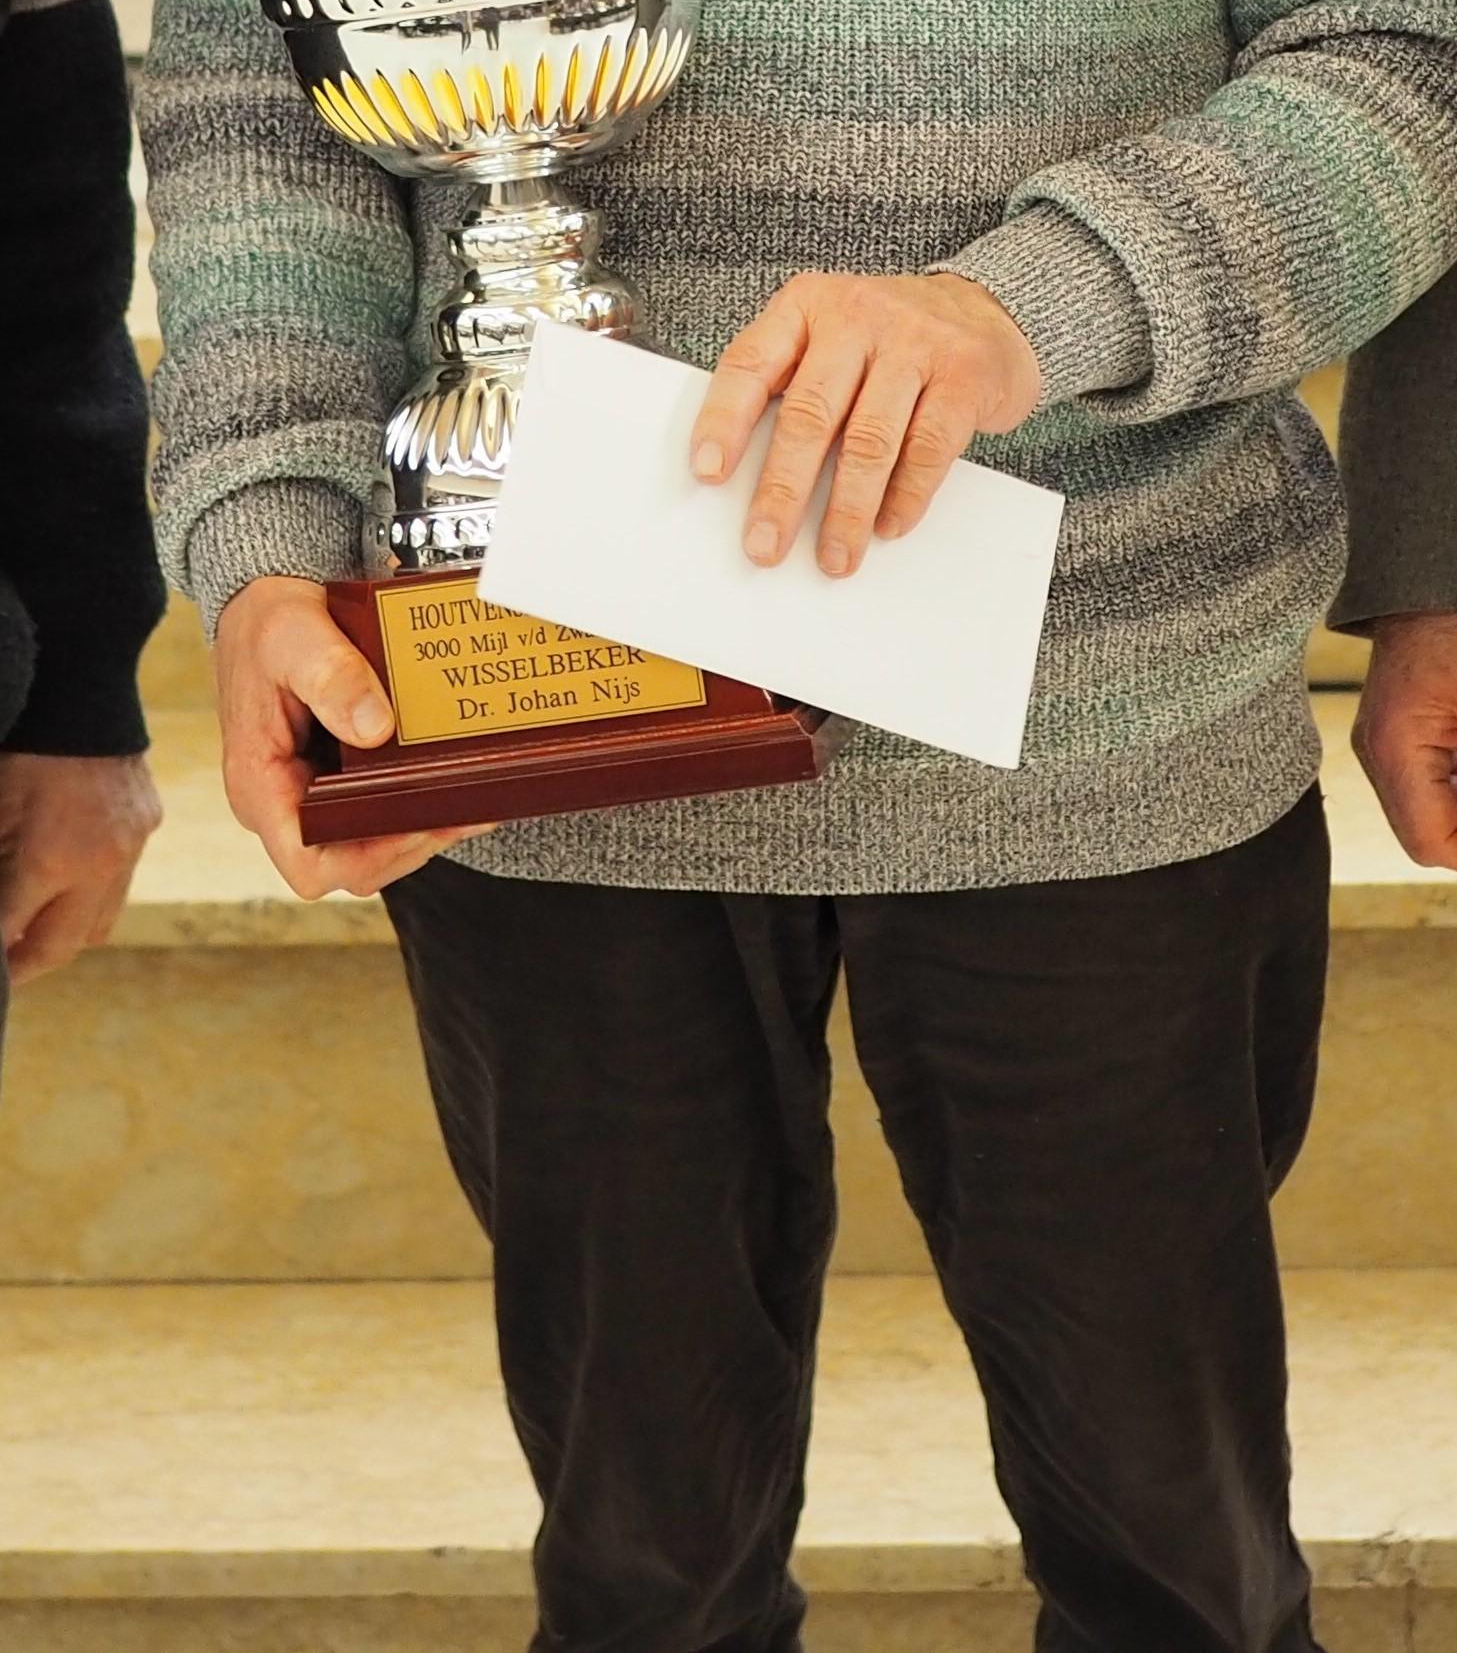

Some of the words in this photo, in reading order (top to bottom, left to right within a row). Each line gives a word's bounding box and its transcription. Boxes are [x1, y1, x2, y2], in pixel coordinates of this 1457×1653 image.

[409, 598, 526, 631] HOUTVEN
[414, 637, 461, 661] 3000
[470, 631, 508, 655] Mijl
[517, 626, 547, 646] v/d
[442, 644, 646, 689] WISSELBEKER
[456, 698, 495, 720] Dr.
[507, 689, 577, 714] Johan
[590, 676, 641, 704] Nijs
